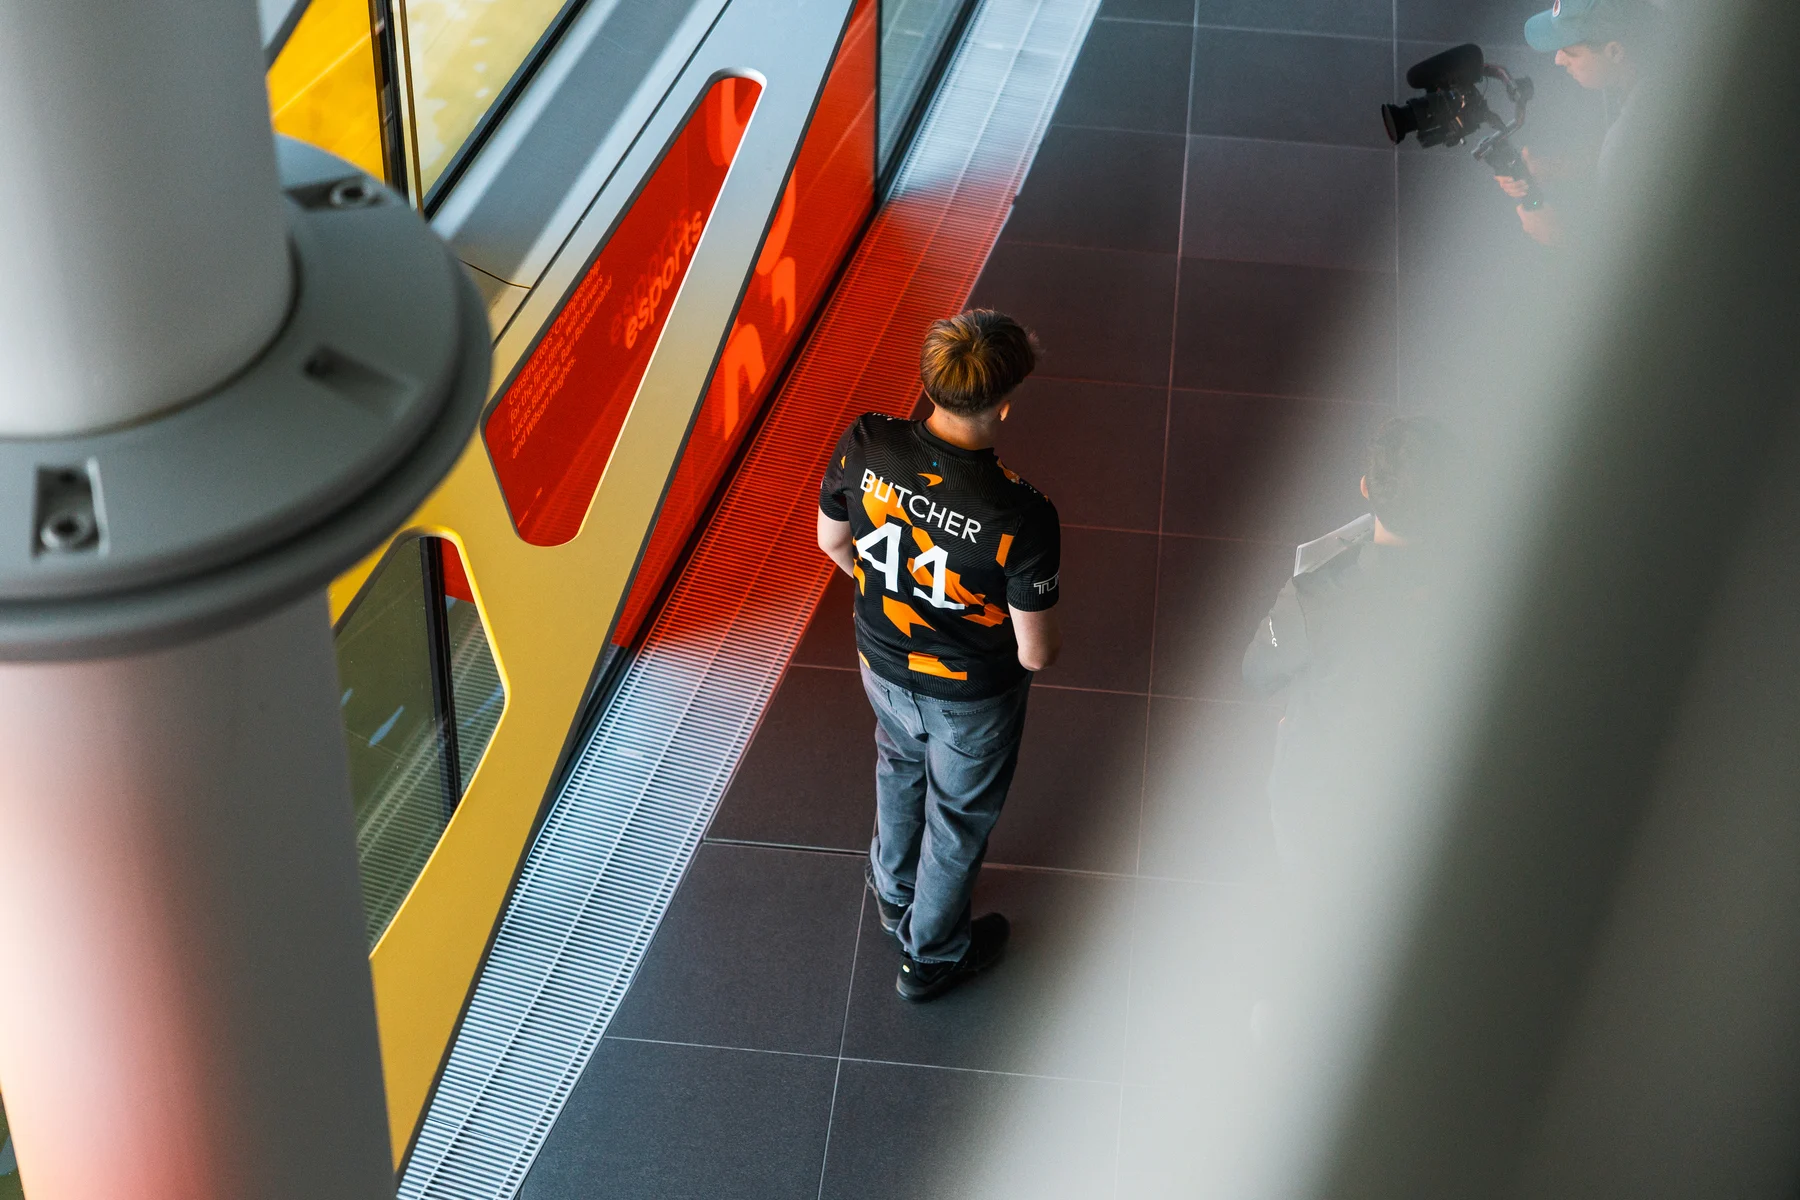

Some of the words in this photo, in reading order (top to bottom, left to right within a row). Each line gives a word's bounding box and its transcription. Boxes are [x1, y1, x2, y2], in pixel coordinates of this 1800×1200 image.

[555, 260, 601, 335] Championship
[625, 210, 703, 350] esports
[510, 402, 521, 424] for
[521, 384, 533, 406] the
[533, 360, 548, 388] first
[565, 310, 581, 337] with
[580, 273, 603, 314] drivers
[511, 405, 531, 442] Lucas
[512, 430, 526, 459] and
[526, 396, 549, 437] Wilson
[860, 468, 982, 544] BUTCHER
[856, 522, 966, 611] 41
